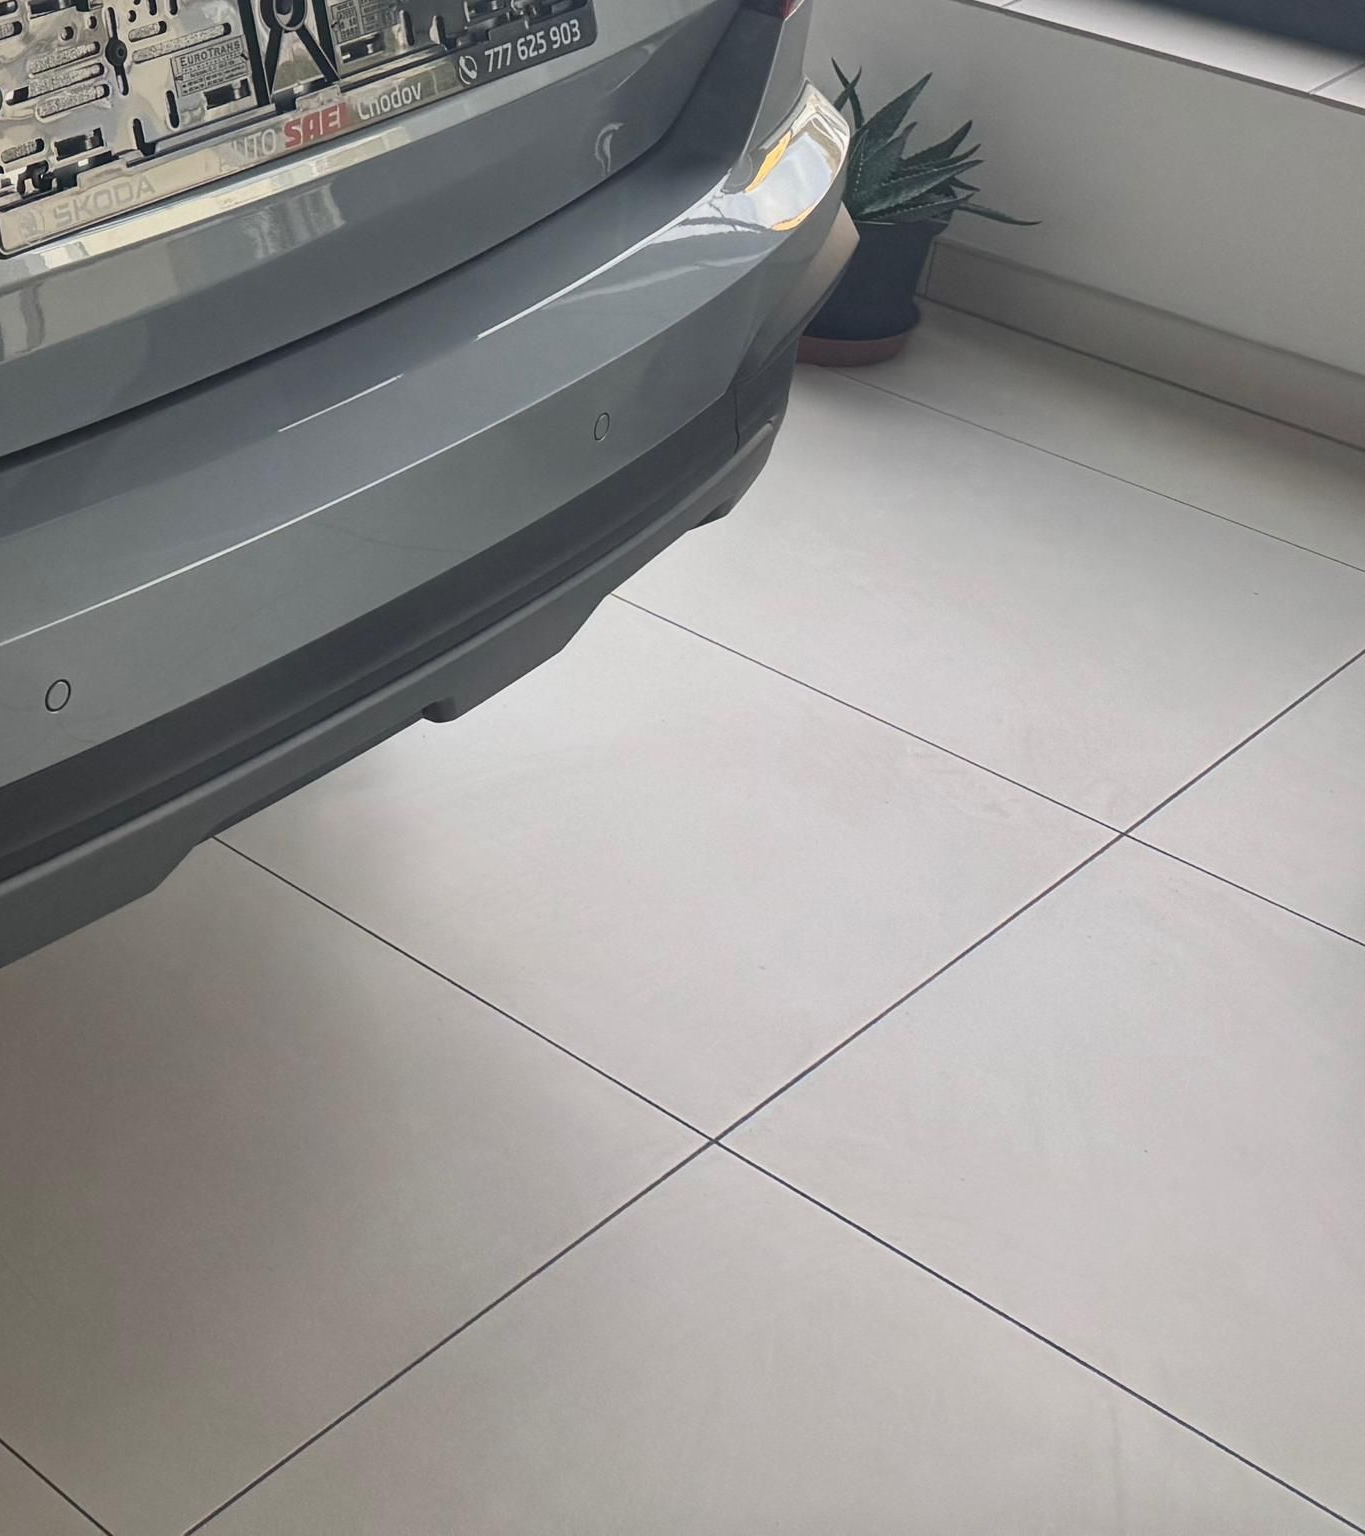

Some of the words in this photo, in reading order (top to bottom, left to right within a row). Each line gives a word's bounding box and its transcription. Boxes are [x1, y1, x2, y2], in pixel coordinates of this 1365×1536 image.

[484, 42, 512, 73] 777
[516, 30, 547, 61] 625
[549, 18, 581, 49] 903
